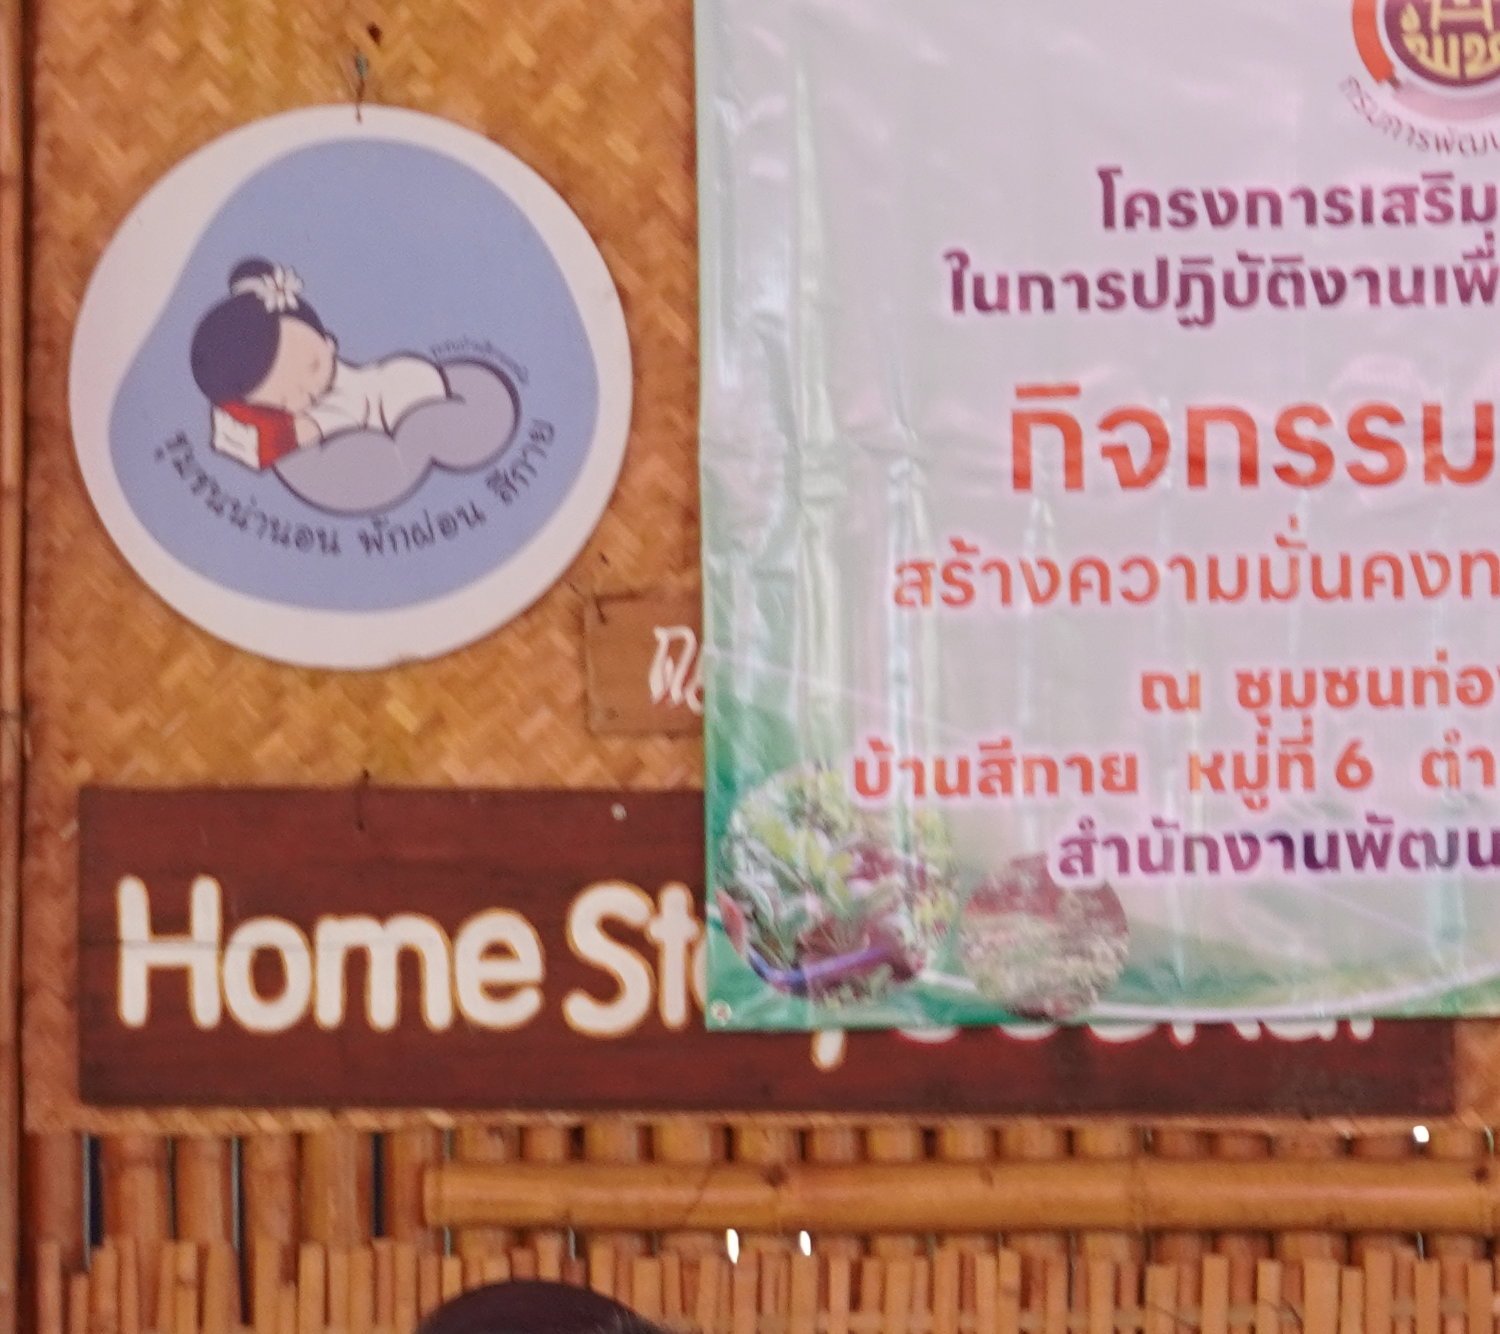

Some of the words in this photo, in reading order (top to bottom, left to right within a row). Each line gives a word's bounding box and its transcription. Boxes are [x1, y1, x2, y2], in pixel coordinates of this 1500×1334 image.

[1140, 670, 1200, 714] ณ
[853, 736, 1141, 798] บ้านสีกาย
[1188, 714, 1316, 812] หมู่ที่
[1334, 736, 1374, 790] 6
[113, 871, 546, 1035] Home
